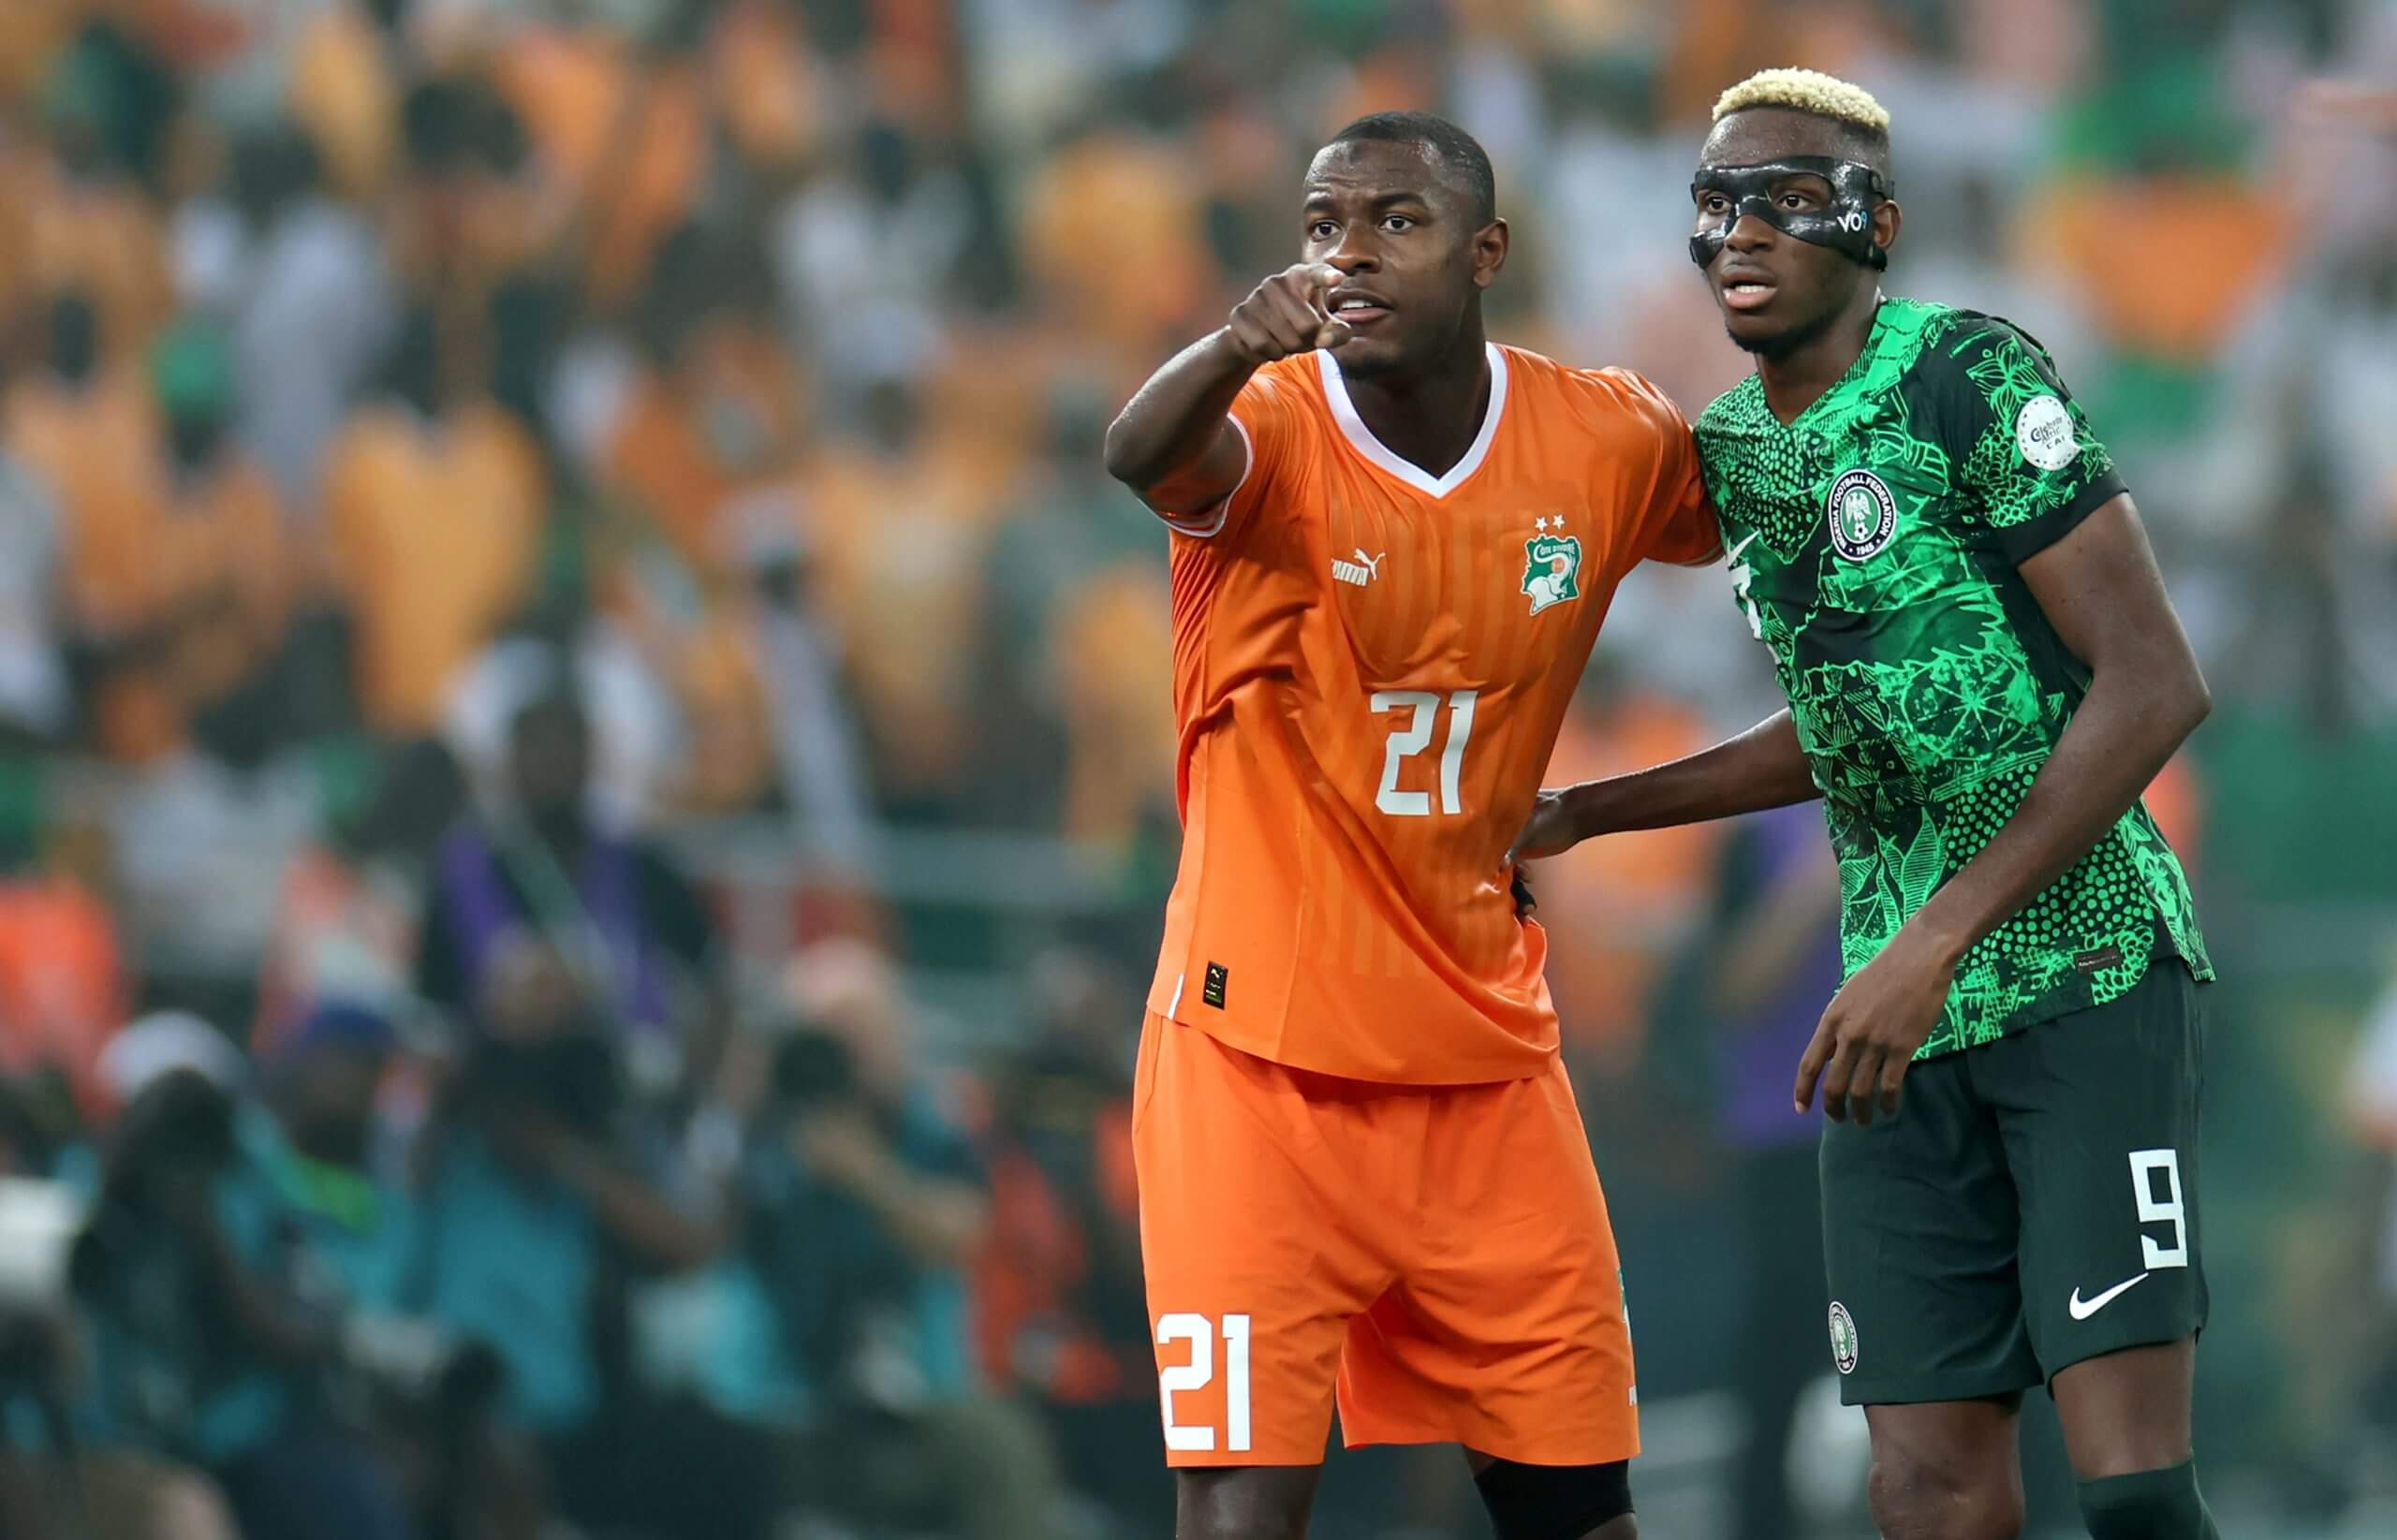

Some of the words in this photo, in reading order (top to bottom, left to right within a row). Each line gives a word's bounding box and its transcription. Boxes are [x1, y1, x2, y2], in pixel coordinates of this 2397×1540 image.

[1832, 474, 1865, 508] FOOTBALL
[1865, 477, 1891, 536] FEDERATION
[1832, 509, 1847, 550] NIGERIA
[1331, 558, 1369, 587] UMA
[1370, 690, 1479, 815] 21
[2128, 1149, 2188, 1269] 9
[1156, 1313, 1251, 1451] 21
